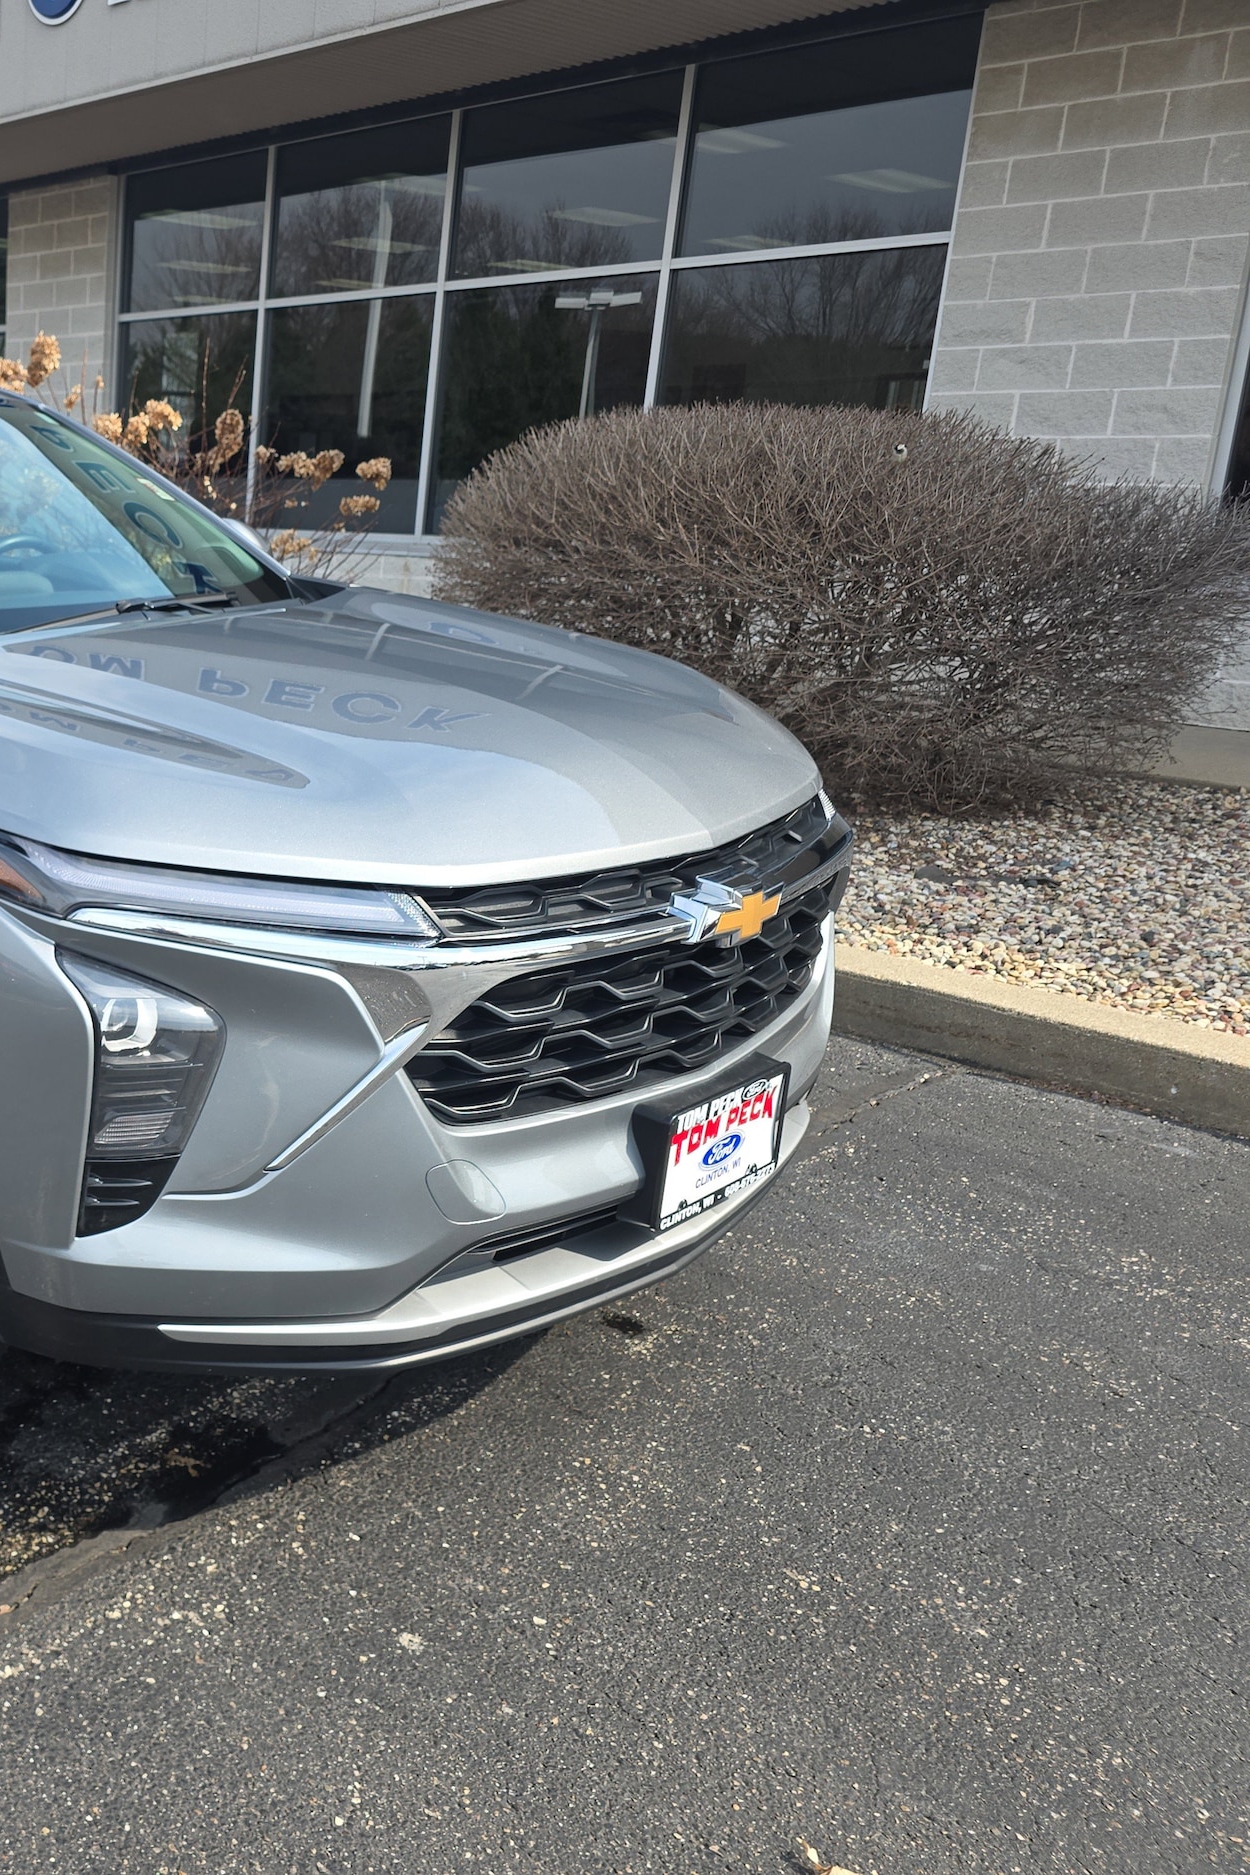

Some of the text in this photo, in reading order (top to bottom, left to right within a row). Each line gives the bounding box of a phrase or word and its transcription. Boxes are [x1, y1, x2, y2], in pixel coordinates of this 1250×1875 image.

[671, 1085, 778, 1167] TOM PECK
[707, 1135, 738, 1165] Ford
[695, 1163, 730, 1189] CLINTON,
[732, 1157, 742, 1170] WI
[659, 1201, 702, 1231] CLINTON,
